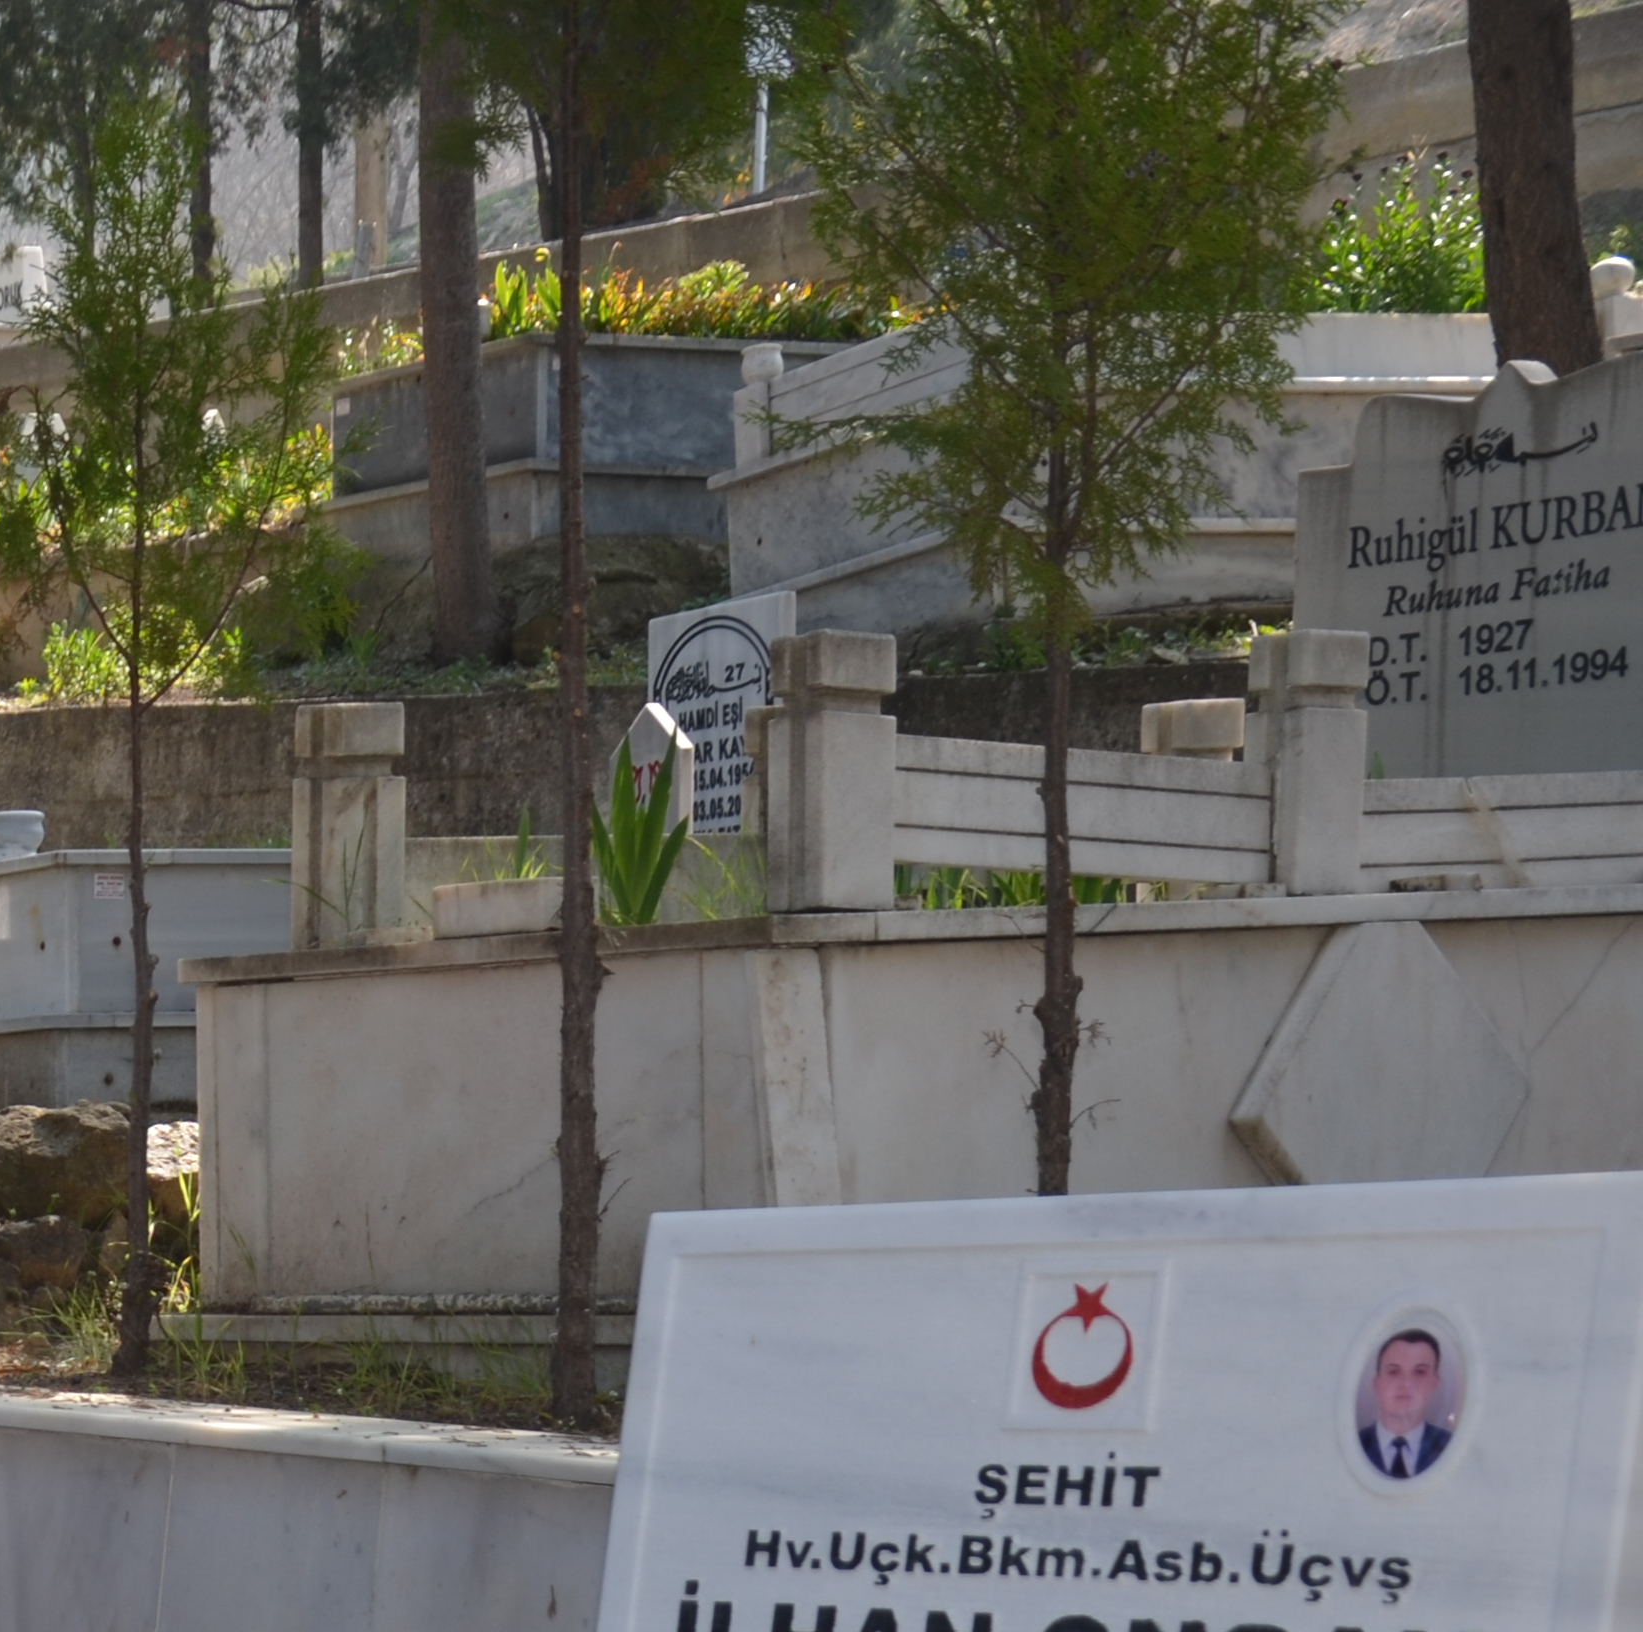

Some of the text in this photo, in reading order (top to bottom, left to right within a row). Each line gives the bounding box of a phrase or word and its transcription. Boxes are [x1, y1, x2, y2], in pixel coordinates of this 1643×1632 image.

[1347, 507, 1478, 571] Ruhigül
[1383, 558, 1611, 616] Ruhuna Fatiha
[724, 662, 744, 682] 27
[1369, 619, 1533, 666] D.T. 1927
[1364, 646, 1629, 705] Ö.T. 18.11.1994
[974, 1452, 1161, 1518] ŞEHİT
[743, 1529, 1413, 1604] Hv.Uçk.Bkm.Asb.Üçvş
